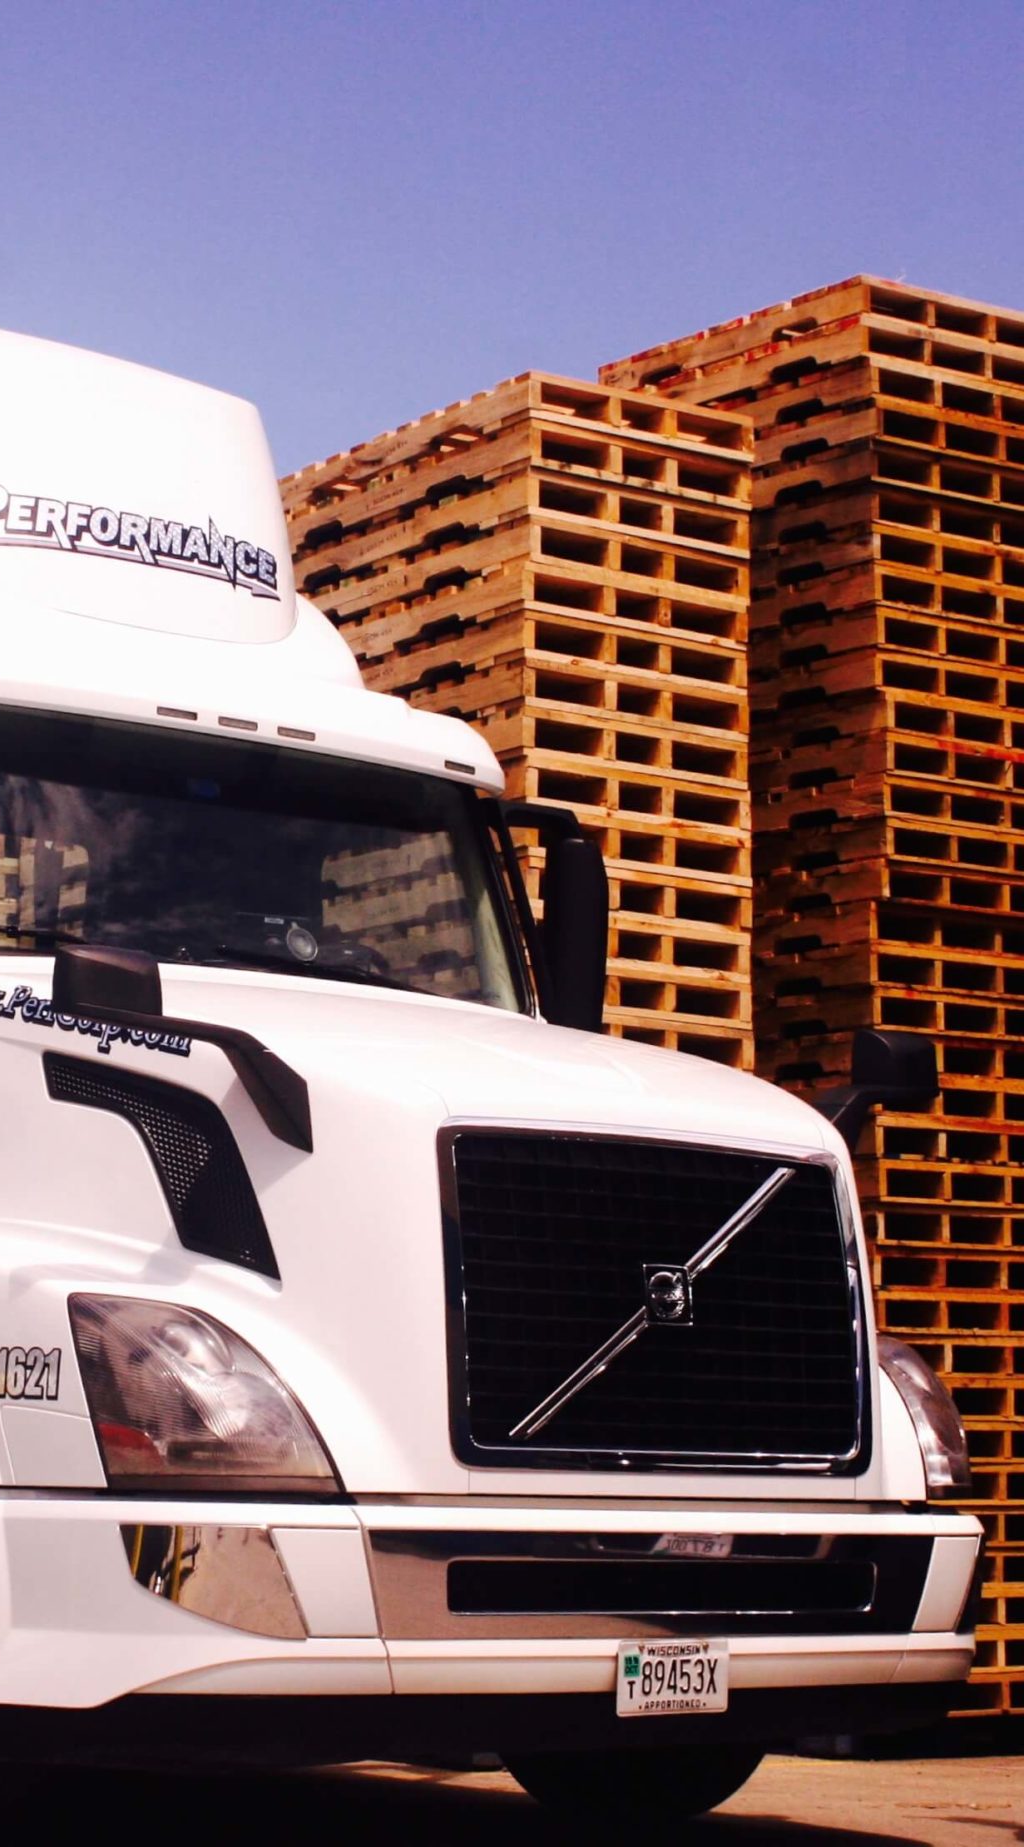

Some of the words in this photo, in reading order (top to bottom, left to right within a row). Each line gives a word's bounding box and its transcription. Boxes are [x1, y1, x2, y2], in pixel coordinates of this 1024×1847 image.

[647, 1644, 700, 1656] WISCONSIN
[627, 1680, 636, 1699] T
[642, 1659, 718, 1696] 89453X
[644, 1699, 701, 1710] APPORTIONED
